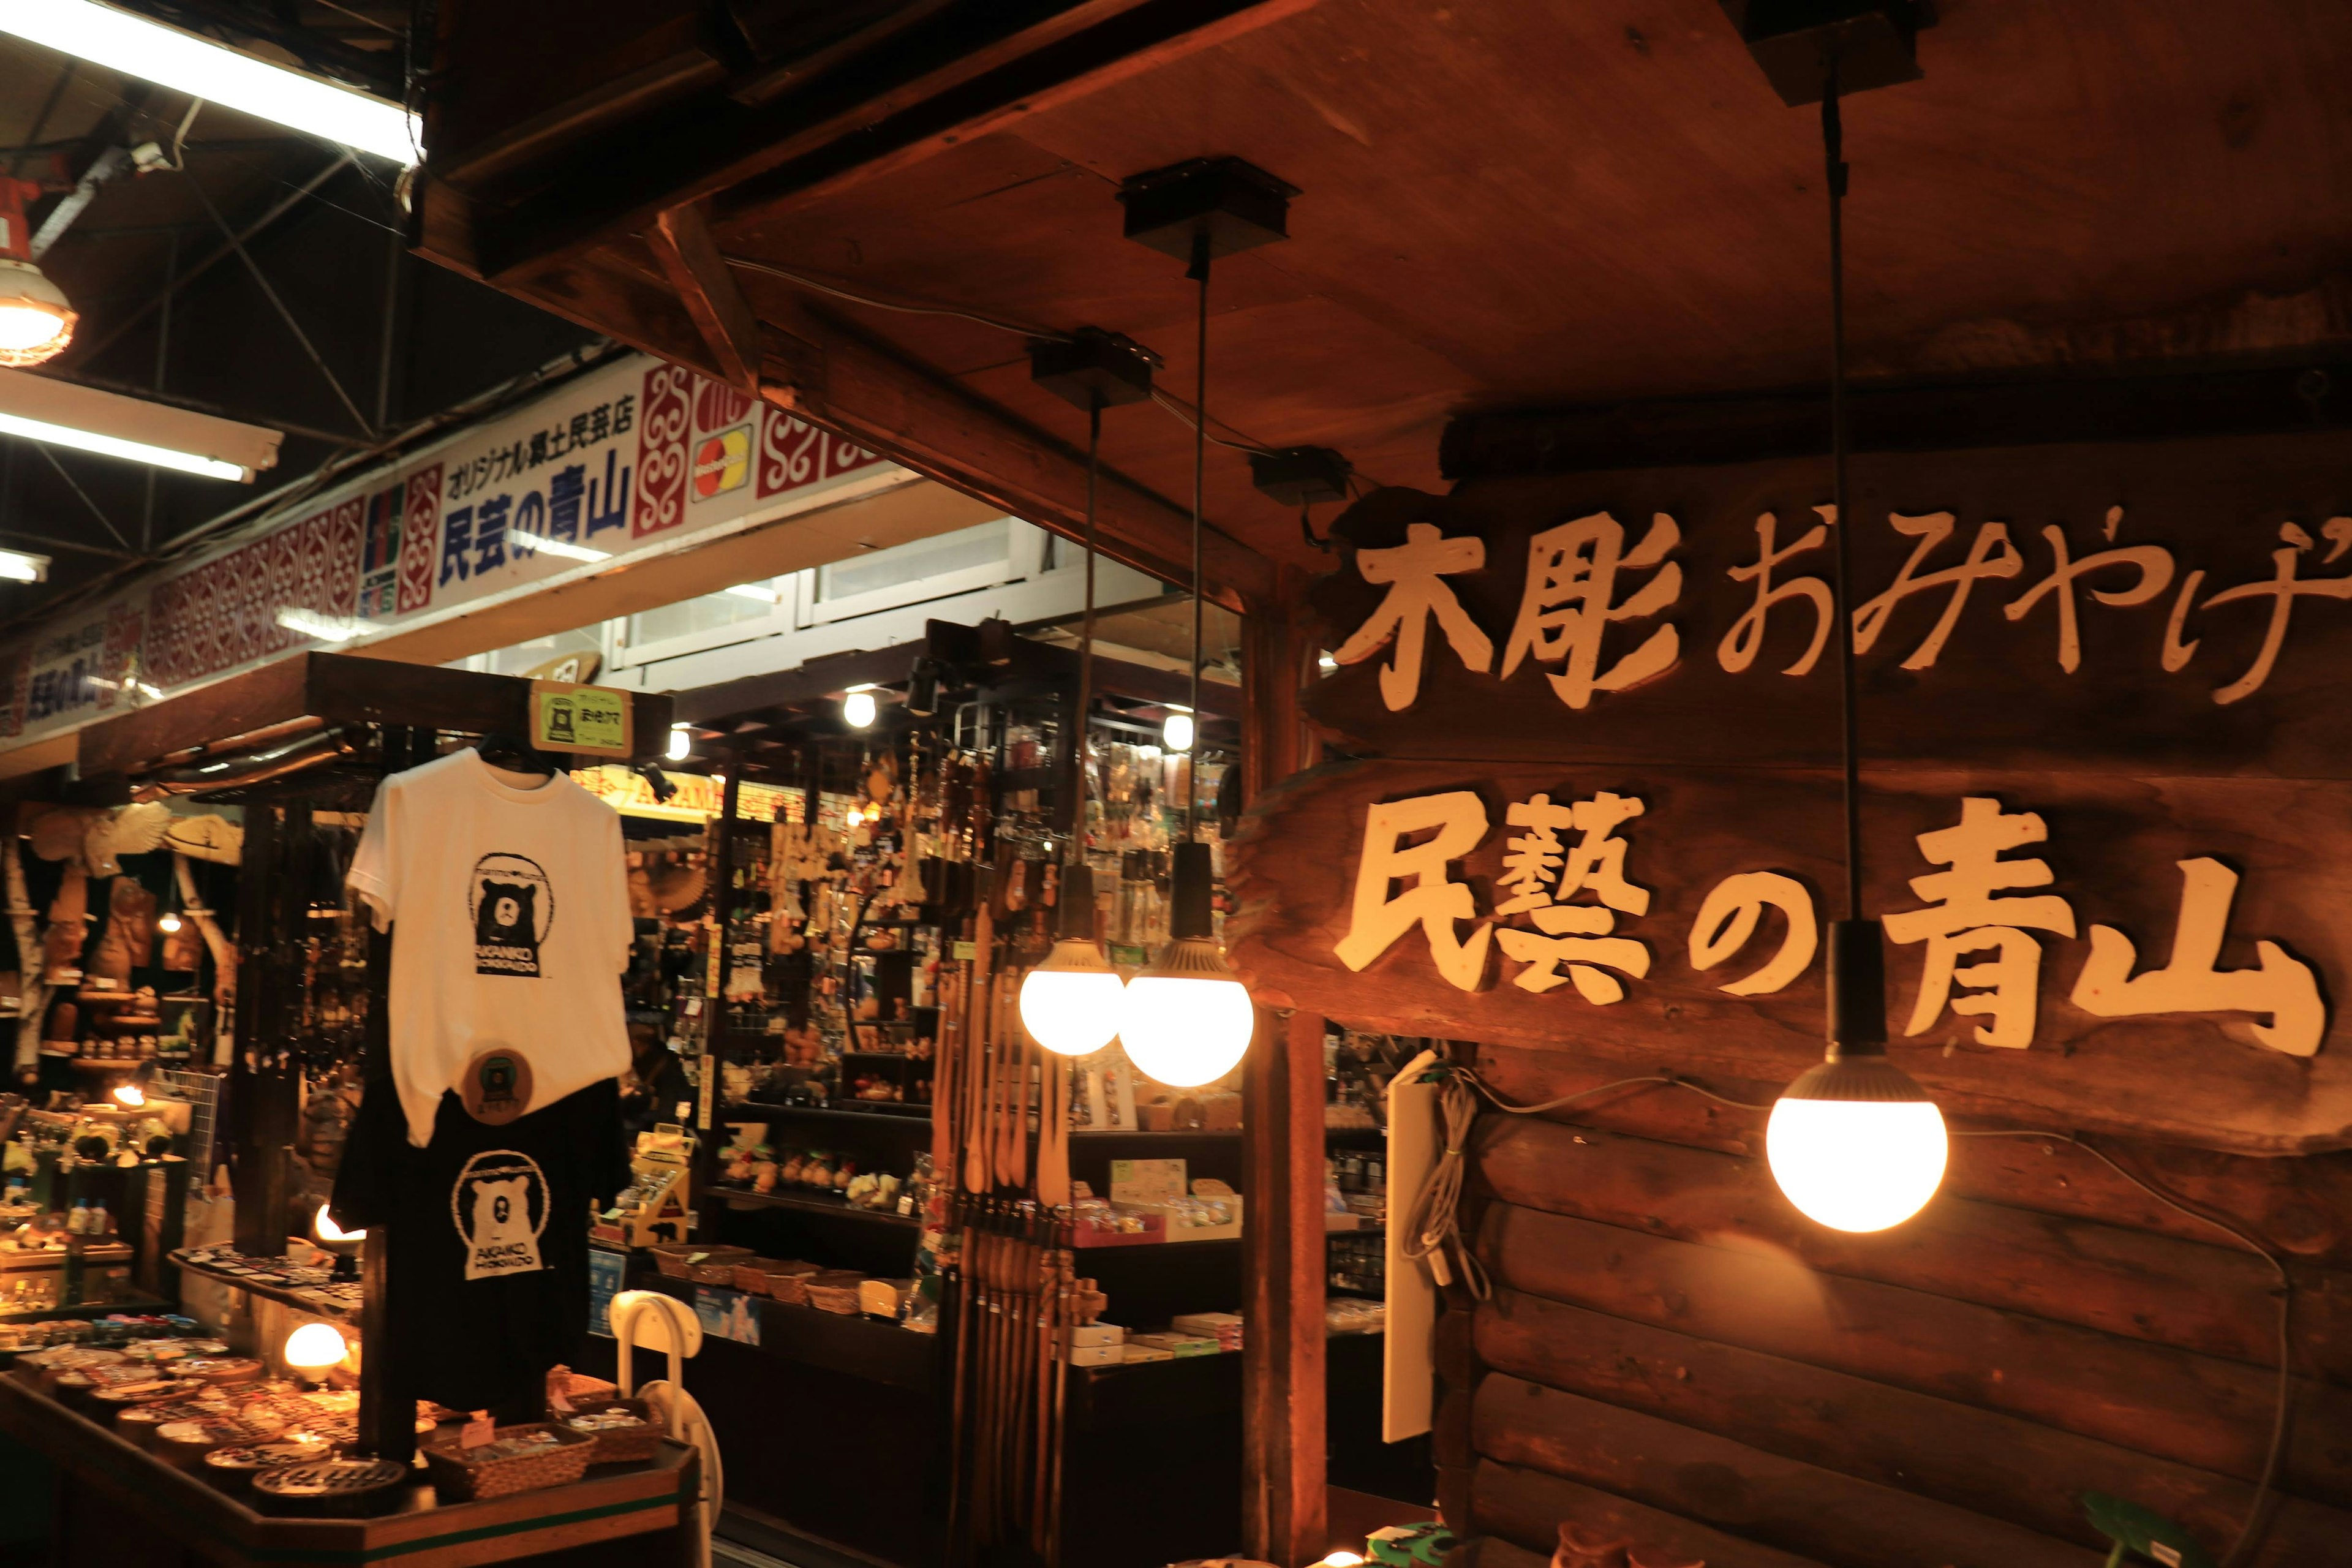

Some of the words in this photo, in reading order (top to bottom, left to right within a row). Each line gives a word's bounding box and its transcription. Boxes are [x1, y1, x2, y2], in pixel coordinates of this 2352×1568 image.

[438, 448, 631, 587] 民芸の青山
[1333, 791, 2326, 1057] 民藝の青山
